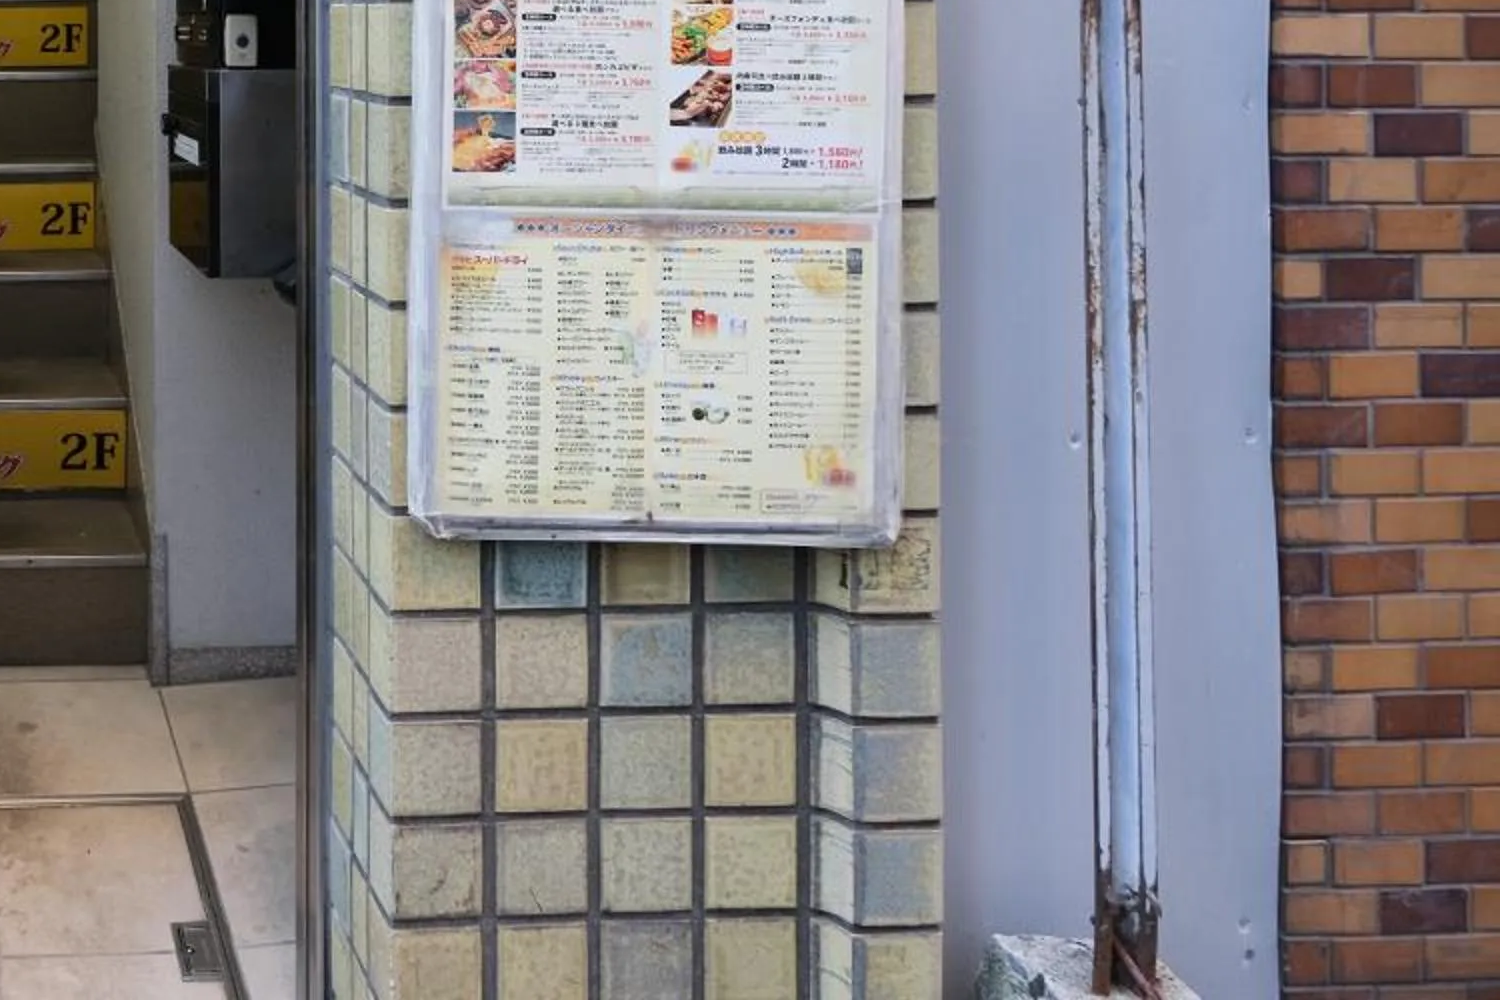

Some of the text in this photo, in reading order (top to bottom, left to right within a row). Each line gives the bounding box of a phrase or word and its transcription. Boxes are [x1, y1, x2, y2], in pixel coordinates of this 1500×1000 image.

[39, 23, 84, 53] 2F
[40, 203, 92, 236] 2F
[60, 432, 120, 471] 2F
